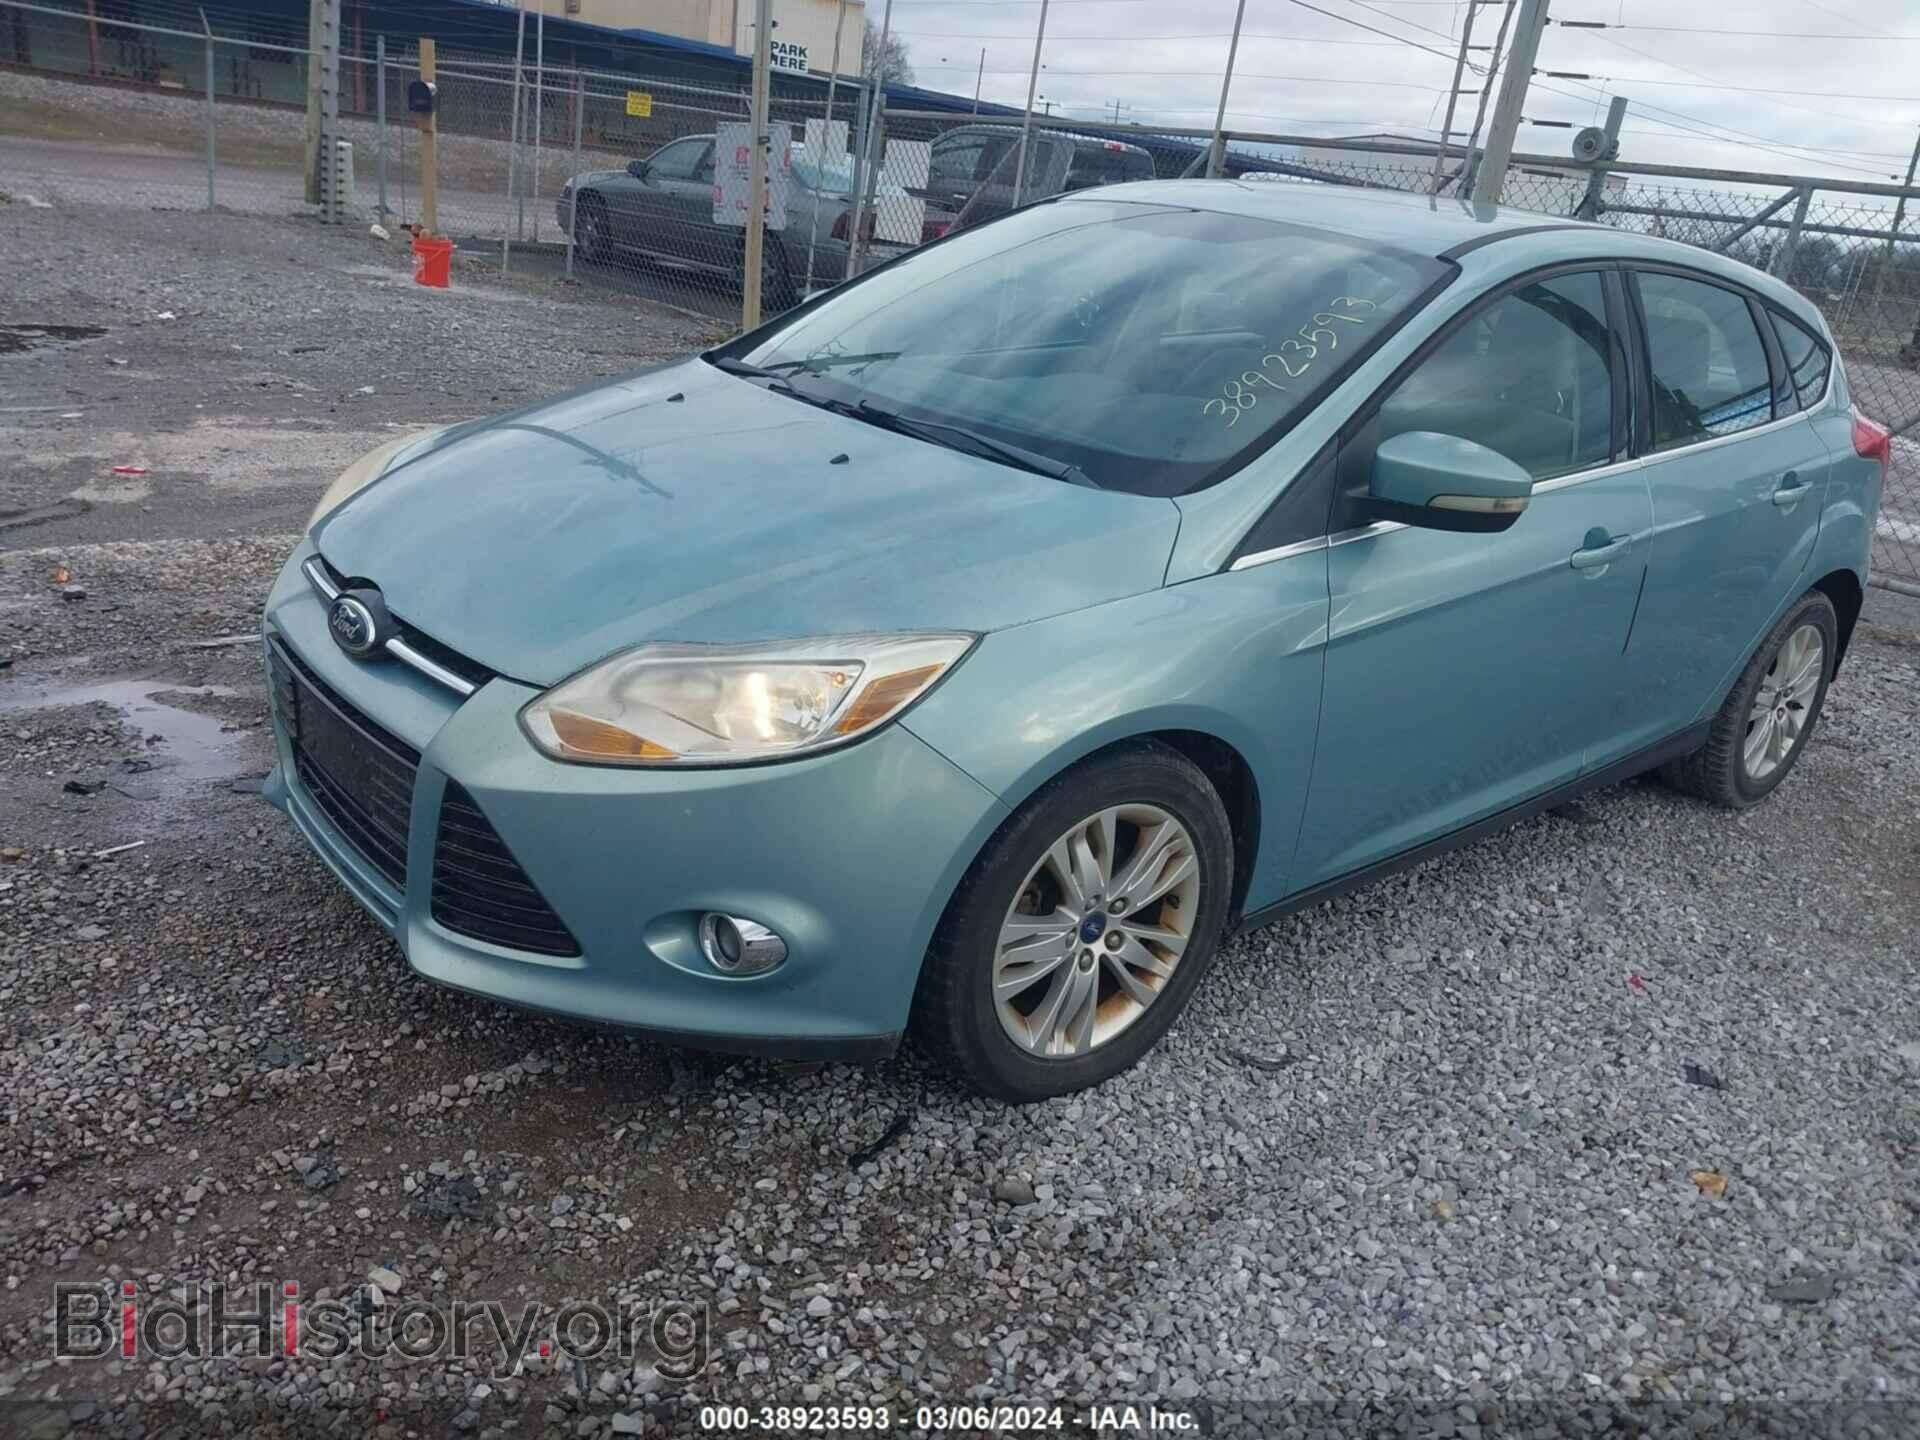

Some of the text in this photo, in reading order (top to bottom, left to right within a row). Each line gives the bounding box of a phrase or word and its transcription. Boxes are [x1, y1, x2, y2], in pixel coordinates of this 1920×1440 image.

[770, 41, 808, 58] PARK
[1202, 296, 1377, 428] 38923593
[332, 604, 361, 639] Ford
